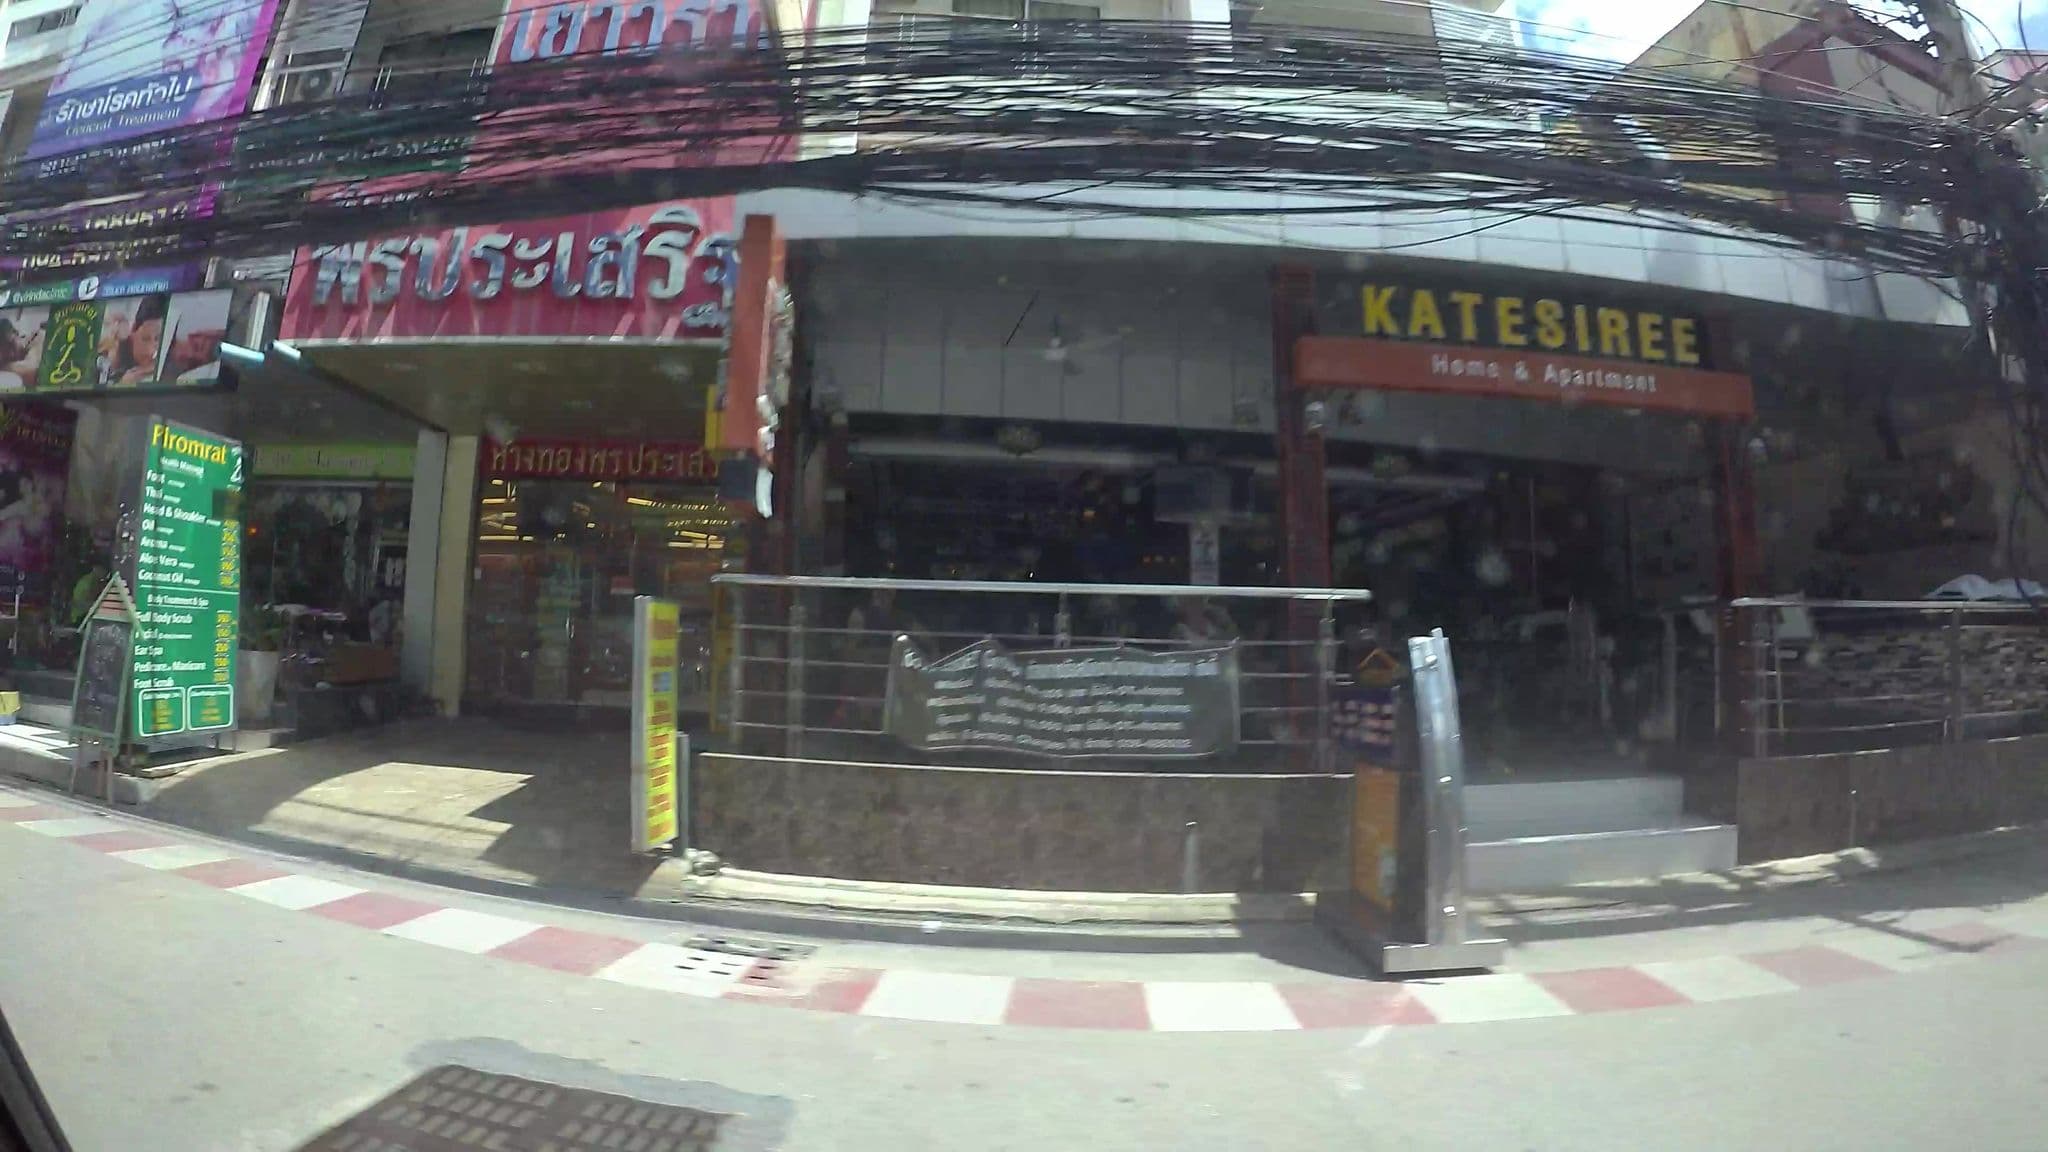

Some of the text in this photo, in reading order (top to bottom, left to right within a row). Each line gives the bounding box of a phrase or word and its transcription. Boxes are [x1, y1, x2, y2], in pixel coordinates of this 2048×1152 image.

[56, 76, 193, 123] รักษาโรคทั่วไป
[118, 106, 181, 127] Treatment
[1361, 284, 1699, 364] KATESIREE
[1431, 353, 1657, 393] Home & Apartment
[143, 503, 165, 517] Head
[159, 554, 178, 567] Vera
[134, 645, 148, 656] Ear
